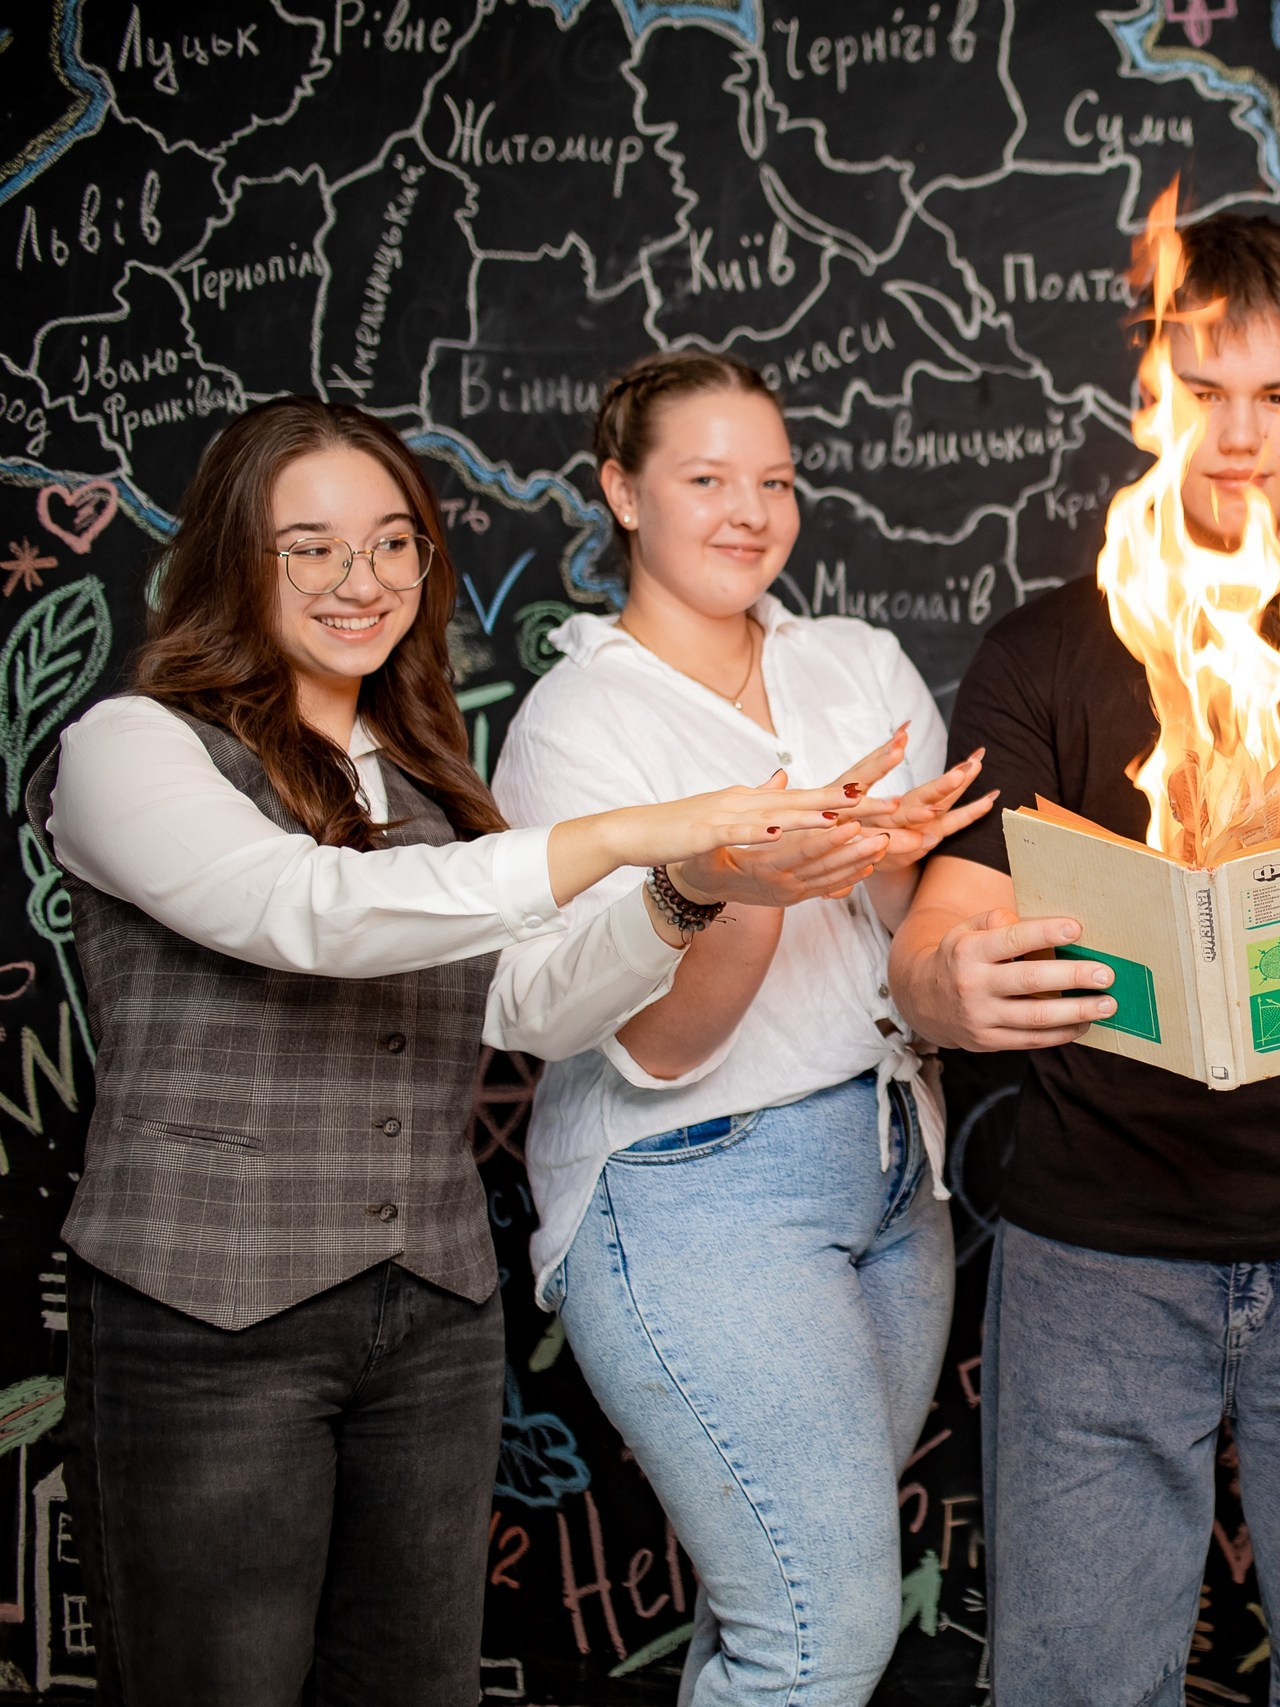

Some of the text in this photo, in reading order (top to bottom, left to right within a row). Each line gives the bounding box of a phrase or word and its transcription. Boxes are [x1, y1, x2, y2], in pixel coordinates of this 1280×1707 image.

[117, 4, 261, 95] Луцьк
[332, 0, 453, 54] Рівне
[772, 0, 978, 92] Чернігів
[445, 93, 645, 198] Житомир
[16, 170, 162, 270] Львів
[689, 222, 797, 295] Київ
[1003, 253, 1138, 309] Полта
[460, 353, 600, 418] Вінни
[812, 559, 995, 625] Миколаїв
